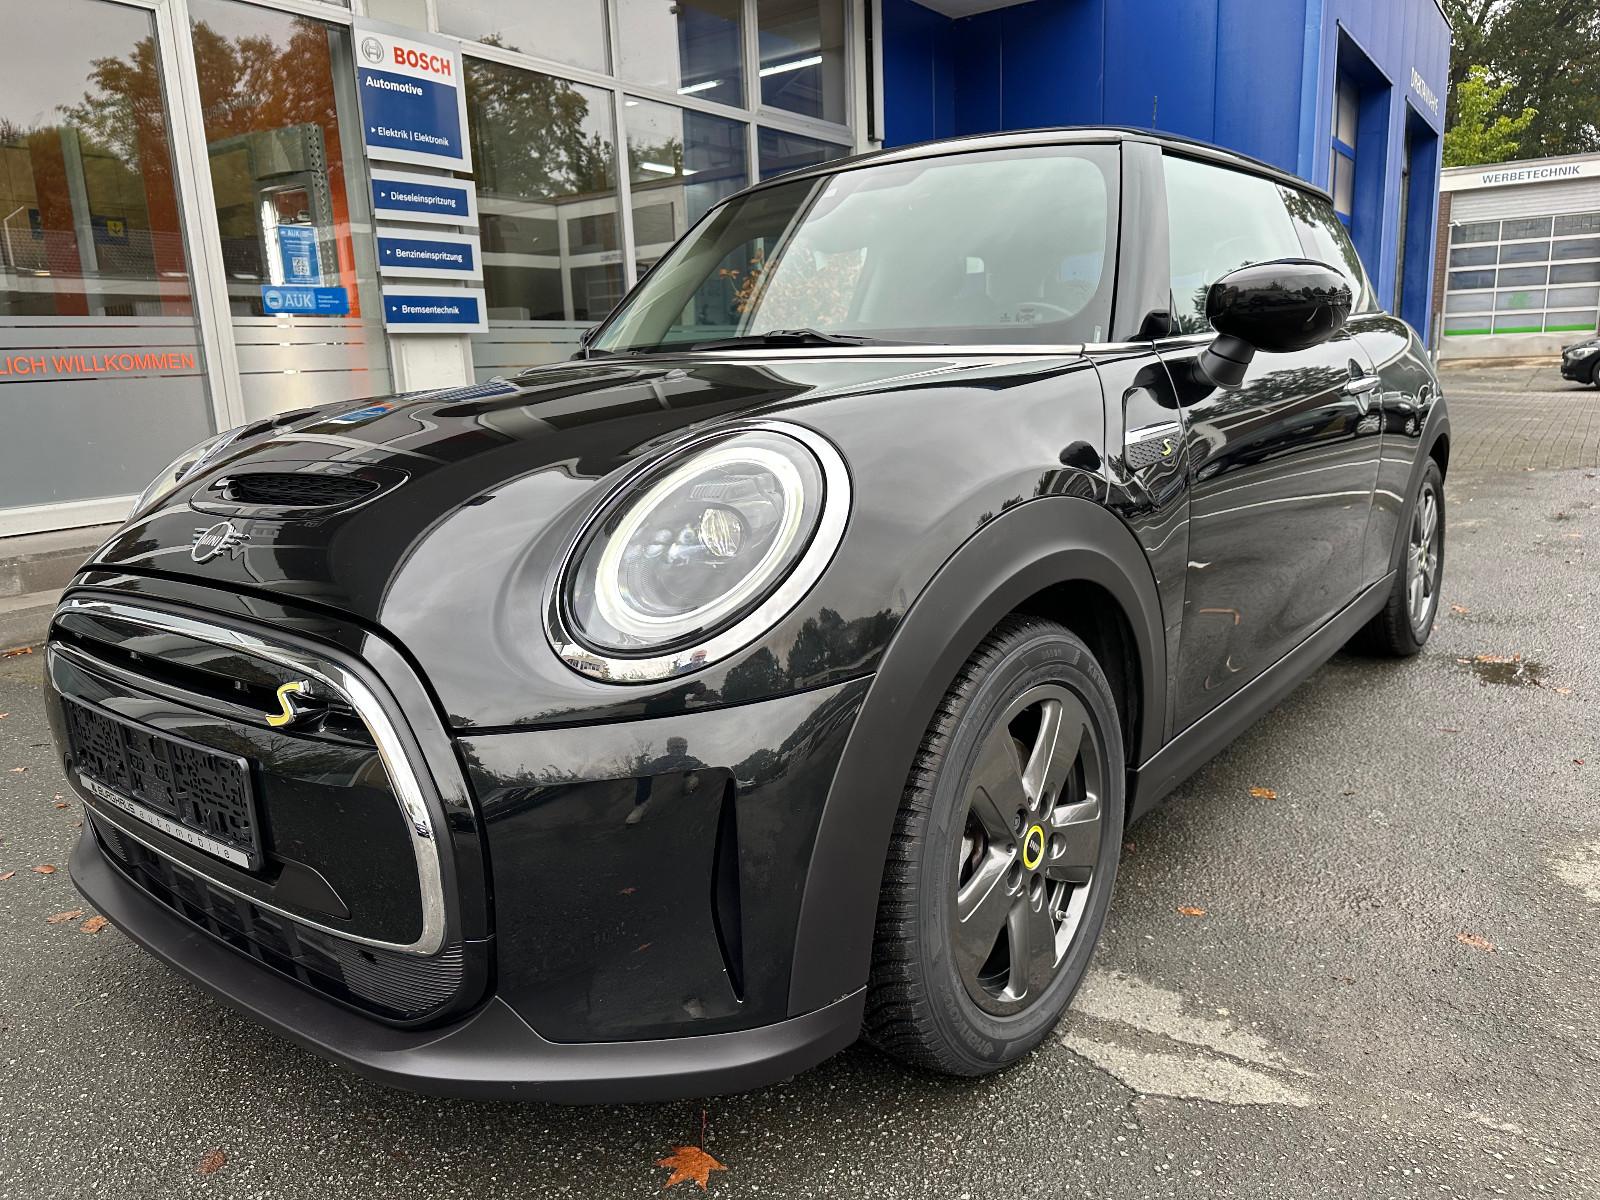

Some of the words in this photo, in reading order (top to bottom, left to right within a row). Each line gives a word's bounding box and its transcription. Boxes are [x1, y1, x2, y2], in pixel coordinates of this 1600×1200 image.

[393, 46, 452, 76] BOSCH
[366, 76, 423, 96] Automotive
[378, 126, 408, 140] Elektrik
[414, 131, 449, 147] Elektronik
[1482, 165, 1581, 183] WERBETECHNIK
[390, 191, 457, 208] Dieseleinspritzung
[396, 248, 463, 263] Benzineinspritzung
[402, 304, 460, 315] Bremsentechnik
[52, 353, 195, 374] WILLKOMMEN
[138, 810, 231, 860] automobile
